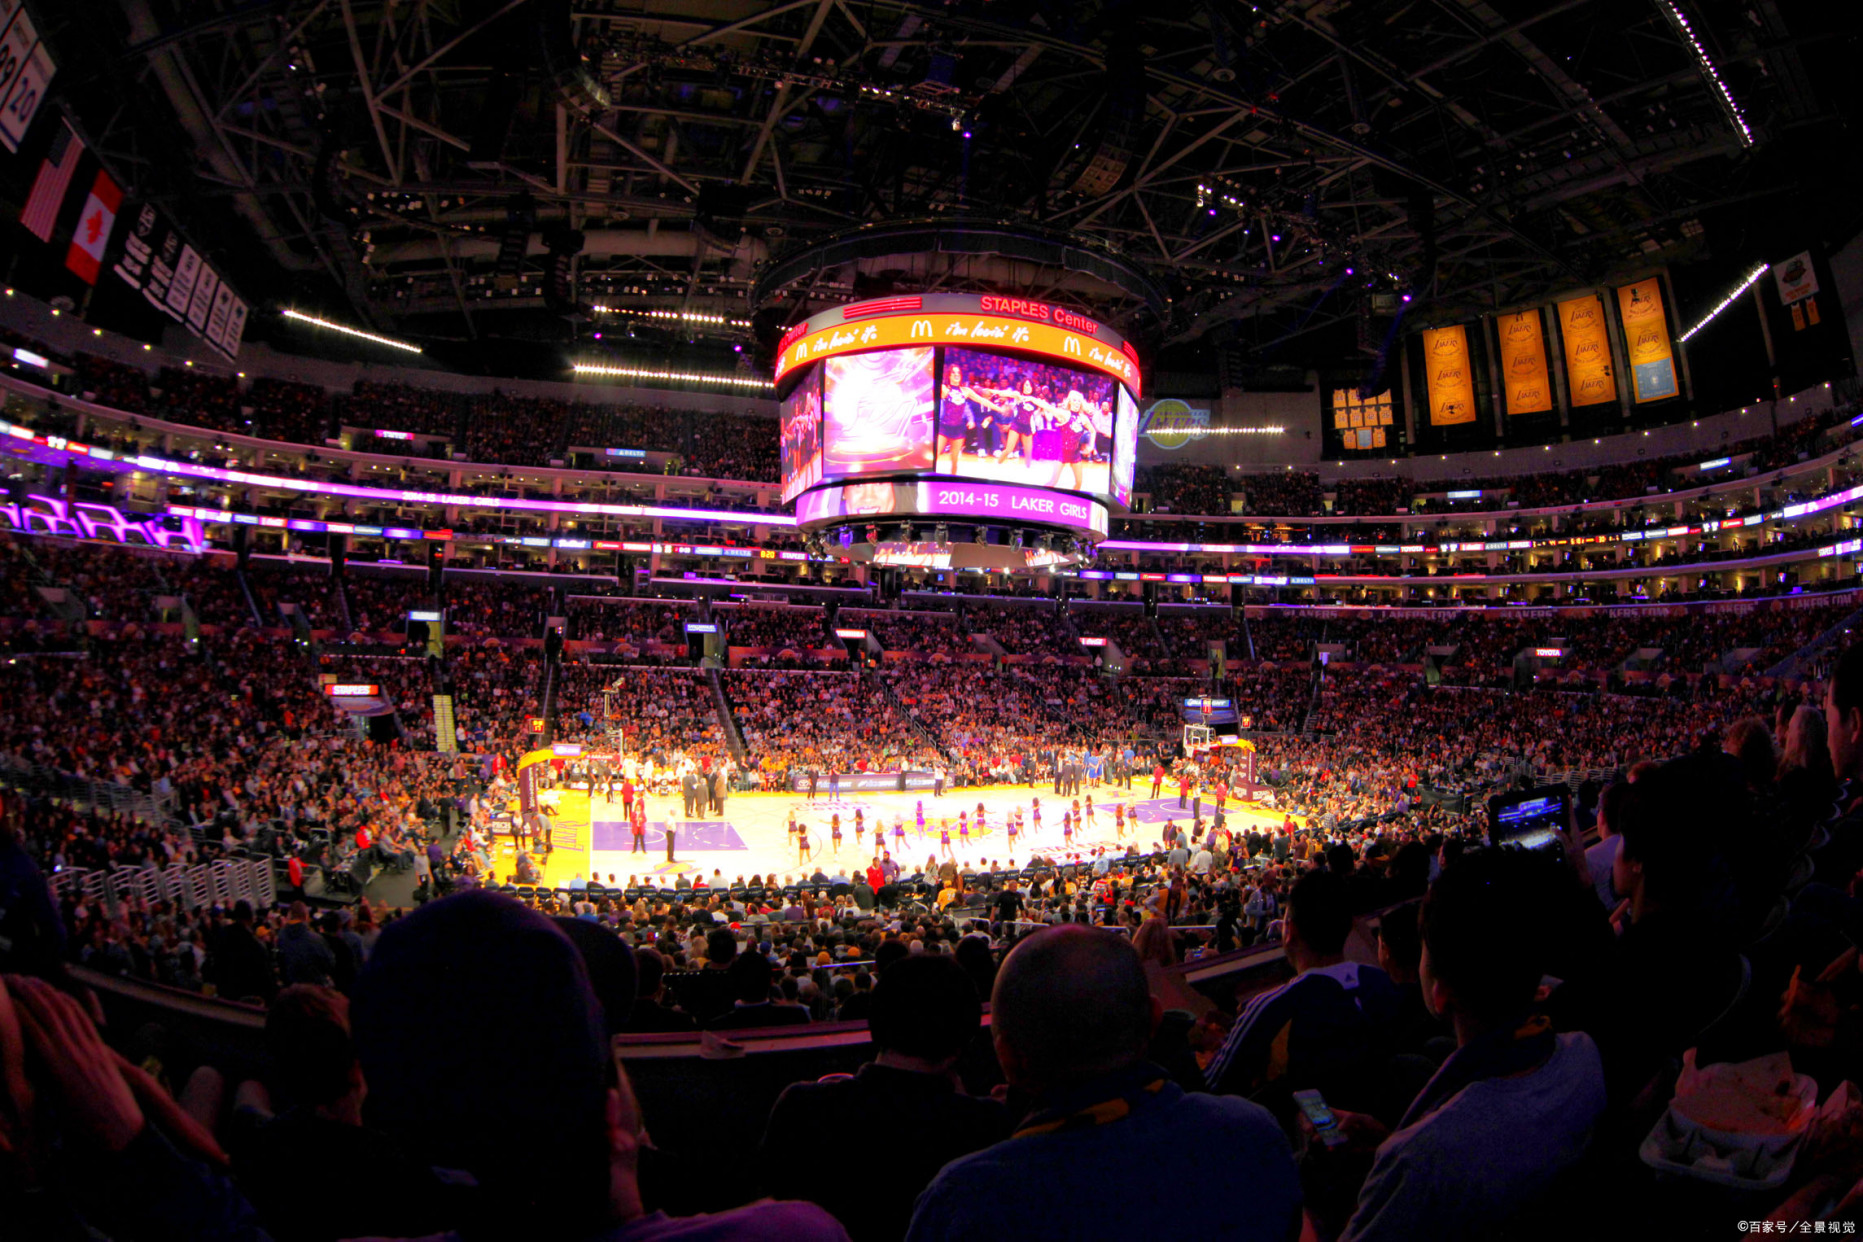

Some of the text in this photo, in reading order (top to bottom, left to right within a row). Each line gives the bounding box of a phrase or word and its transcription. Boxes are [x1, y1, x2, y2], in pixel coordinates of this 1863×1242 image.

[10, 77, 36, 122] 20
[981, 295, 1098, 334] STAPLES Center
[1575, 343, 1599, 356] LAKERS
[938, 491, 1087, 520] 2014-15 LAKER GIRLS
[730, 549, 751, 557] DELTA
[332, 685, 371, 695] STAPLES
[553, 821, 589, 852] LAKERS
